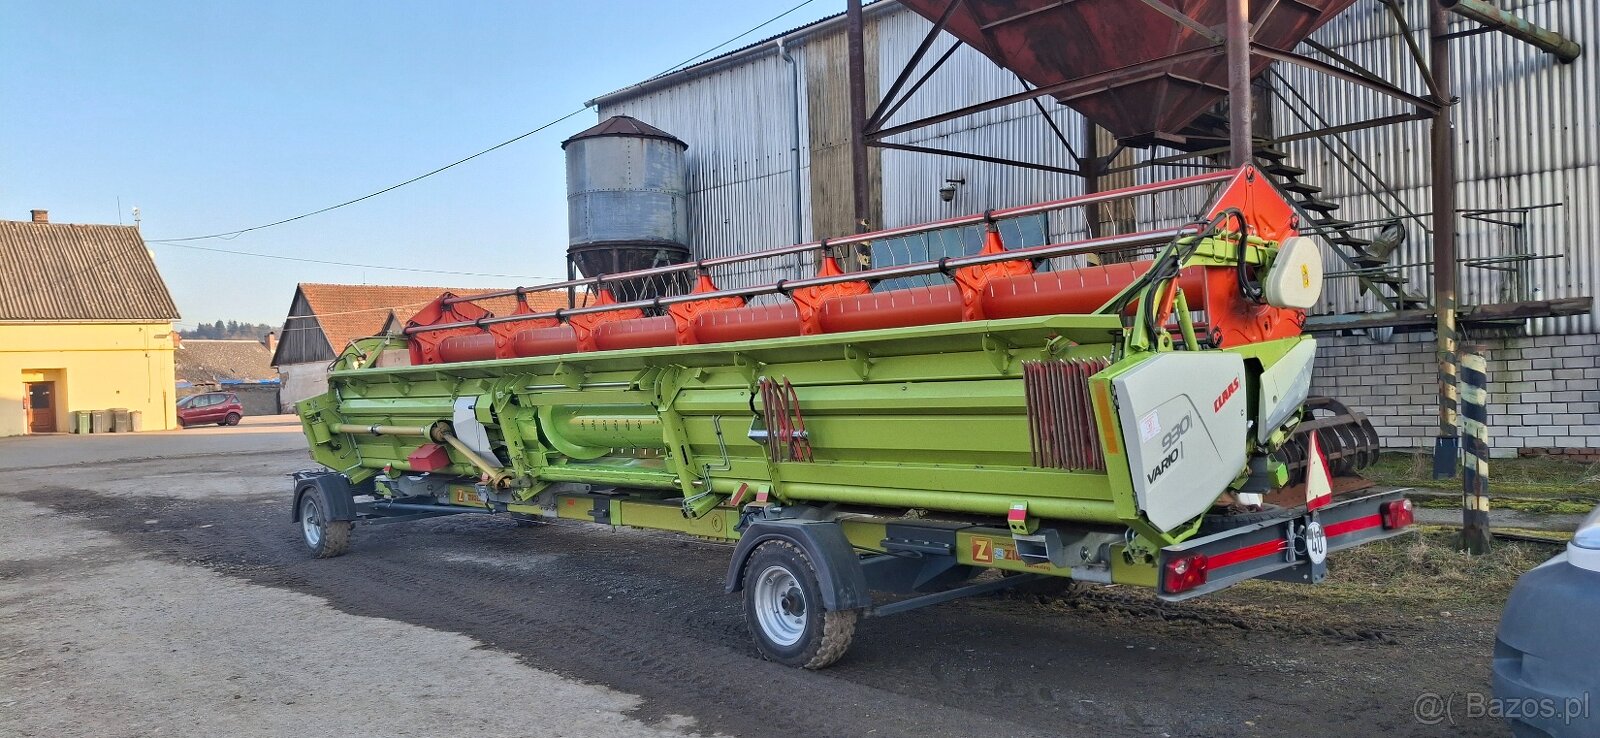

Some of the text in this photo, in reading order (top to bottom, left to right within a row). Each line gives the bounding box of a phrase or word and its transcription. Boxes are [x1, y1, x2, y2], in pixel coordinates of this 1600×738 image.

[1213, 377, 1239, 414] CLAAS
[1147, 448, 1179, 485] VARIO
[1311, 526, 1323, 555] 40
